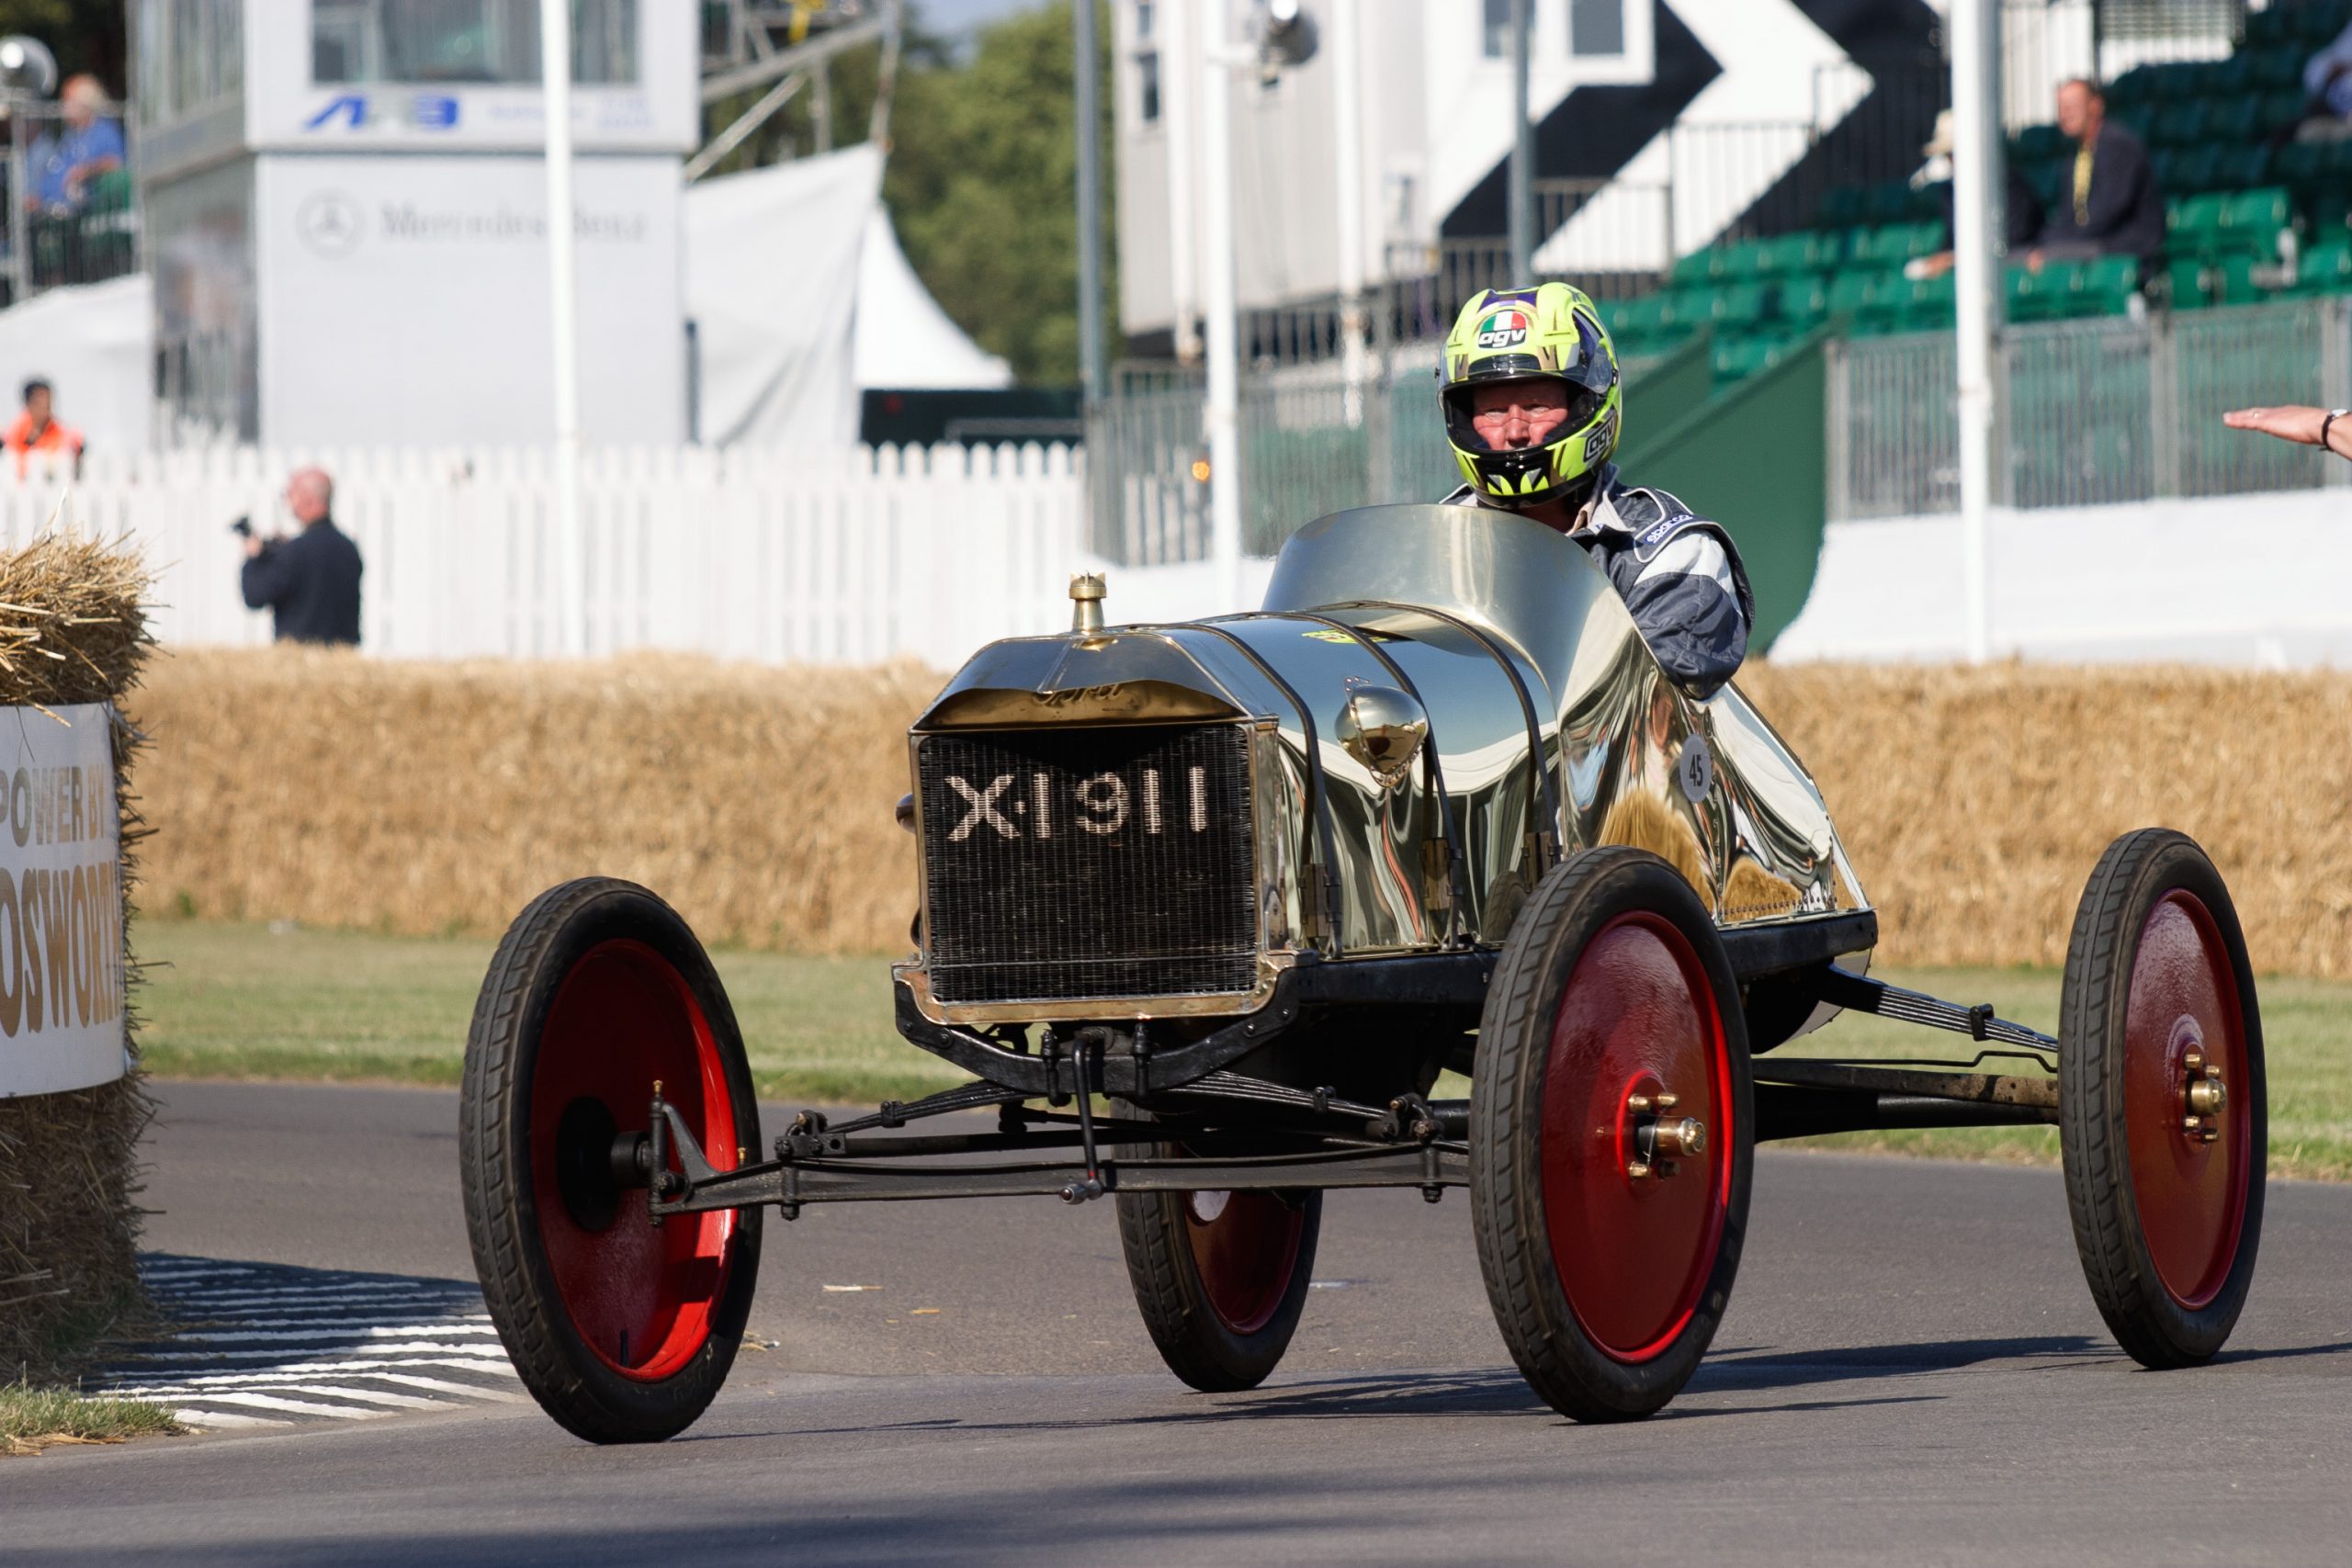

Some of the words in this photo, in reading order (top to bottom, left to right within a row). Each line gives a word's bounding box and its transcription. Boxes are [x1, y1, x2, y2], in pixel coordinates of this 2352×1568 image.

[1478, 329, 1526, 348] agv
[1588, 416, 1615, 456] agv
[1645, 514, 1693, 544] sparco
[1689, 754, 1703, 787] 45
[87, 763, 105, 840] BY
